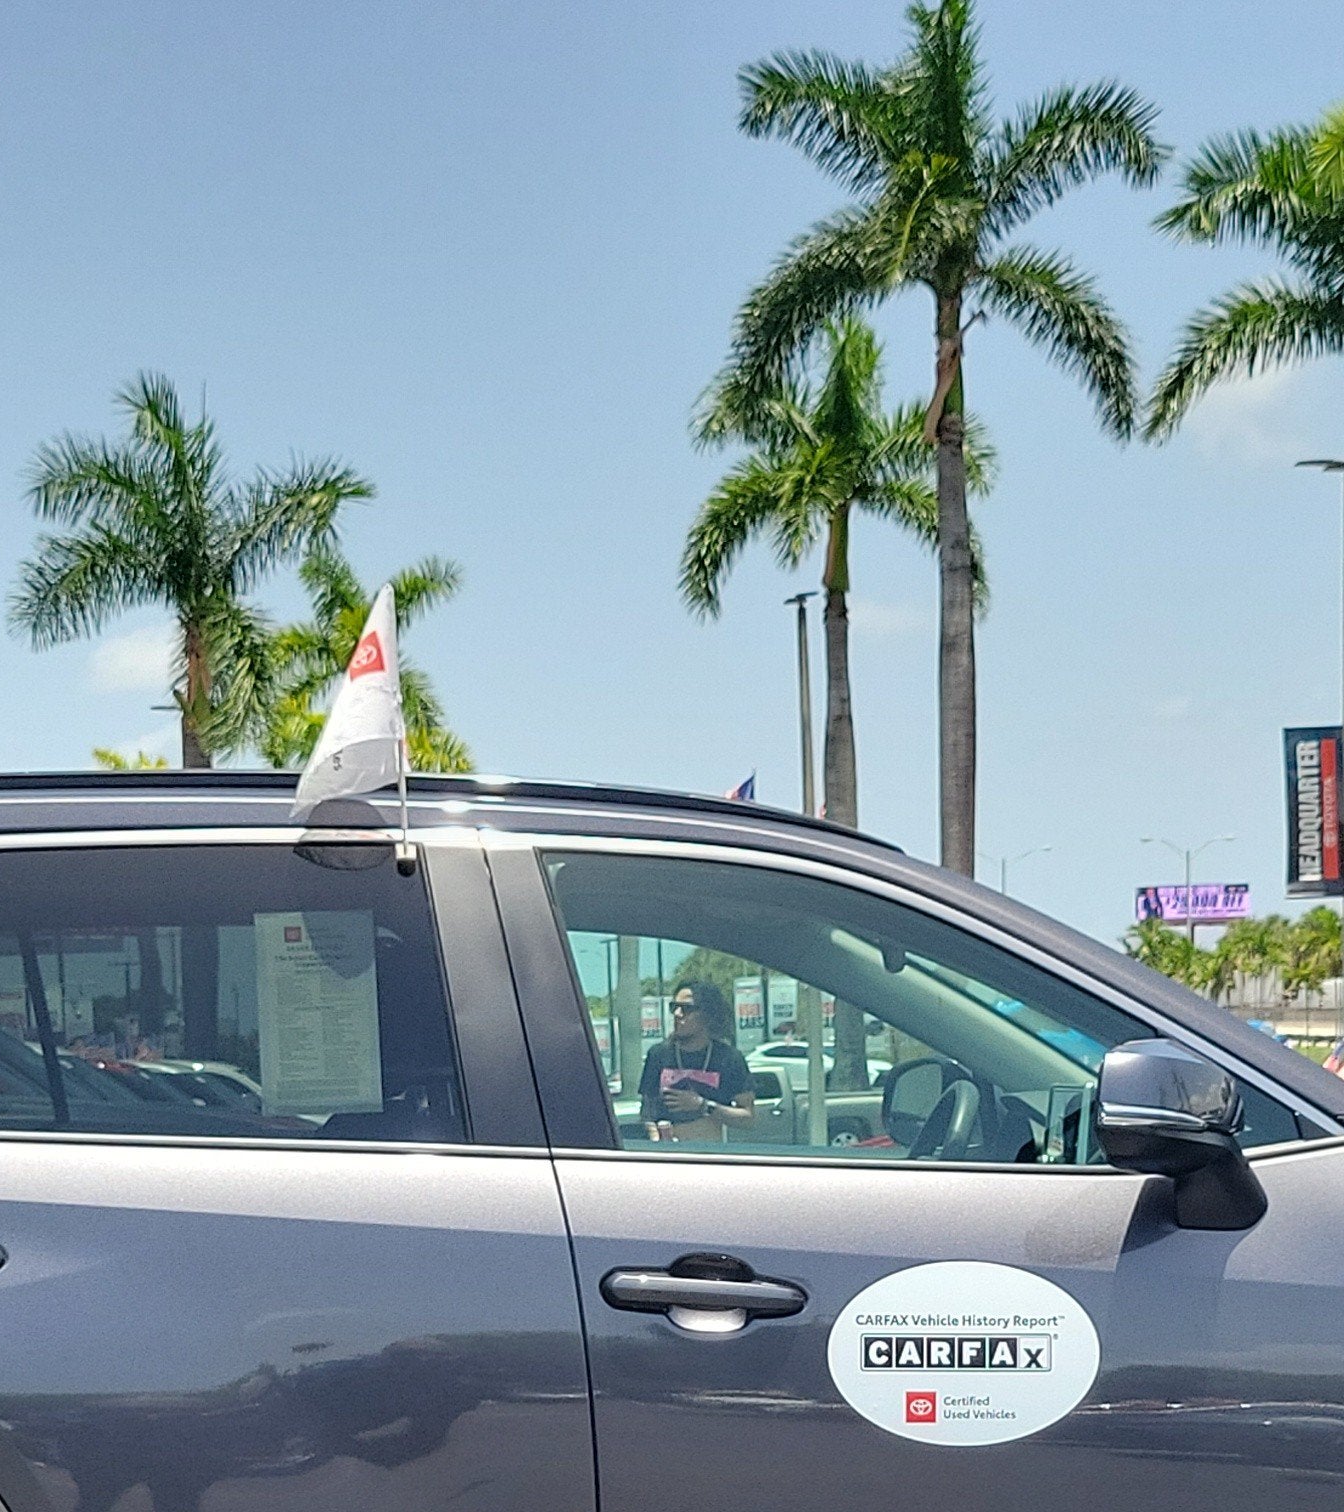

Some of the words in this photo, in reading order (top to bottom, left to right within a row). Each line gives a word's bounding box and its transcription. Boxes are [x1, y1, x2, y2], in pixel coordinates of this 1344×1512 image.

[1296, 740, 1322, 881] HEADQUARTER
[855, 1314, 909, 1327] CARFAX
[911, 1314, 959, 1327] Vehicle
[961, 1314, 1010, 1329] History
[864, 1336, 1049, 1369] CARFAX
[943, 1395, 990, 1407] Certified
[943, 1409, 970, 1420] Used
[972, 1409, 1016, 1420] Vehicles
